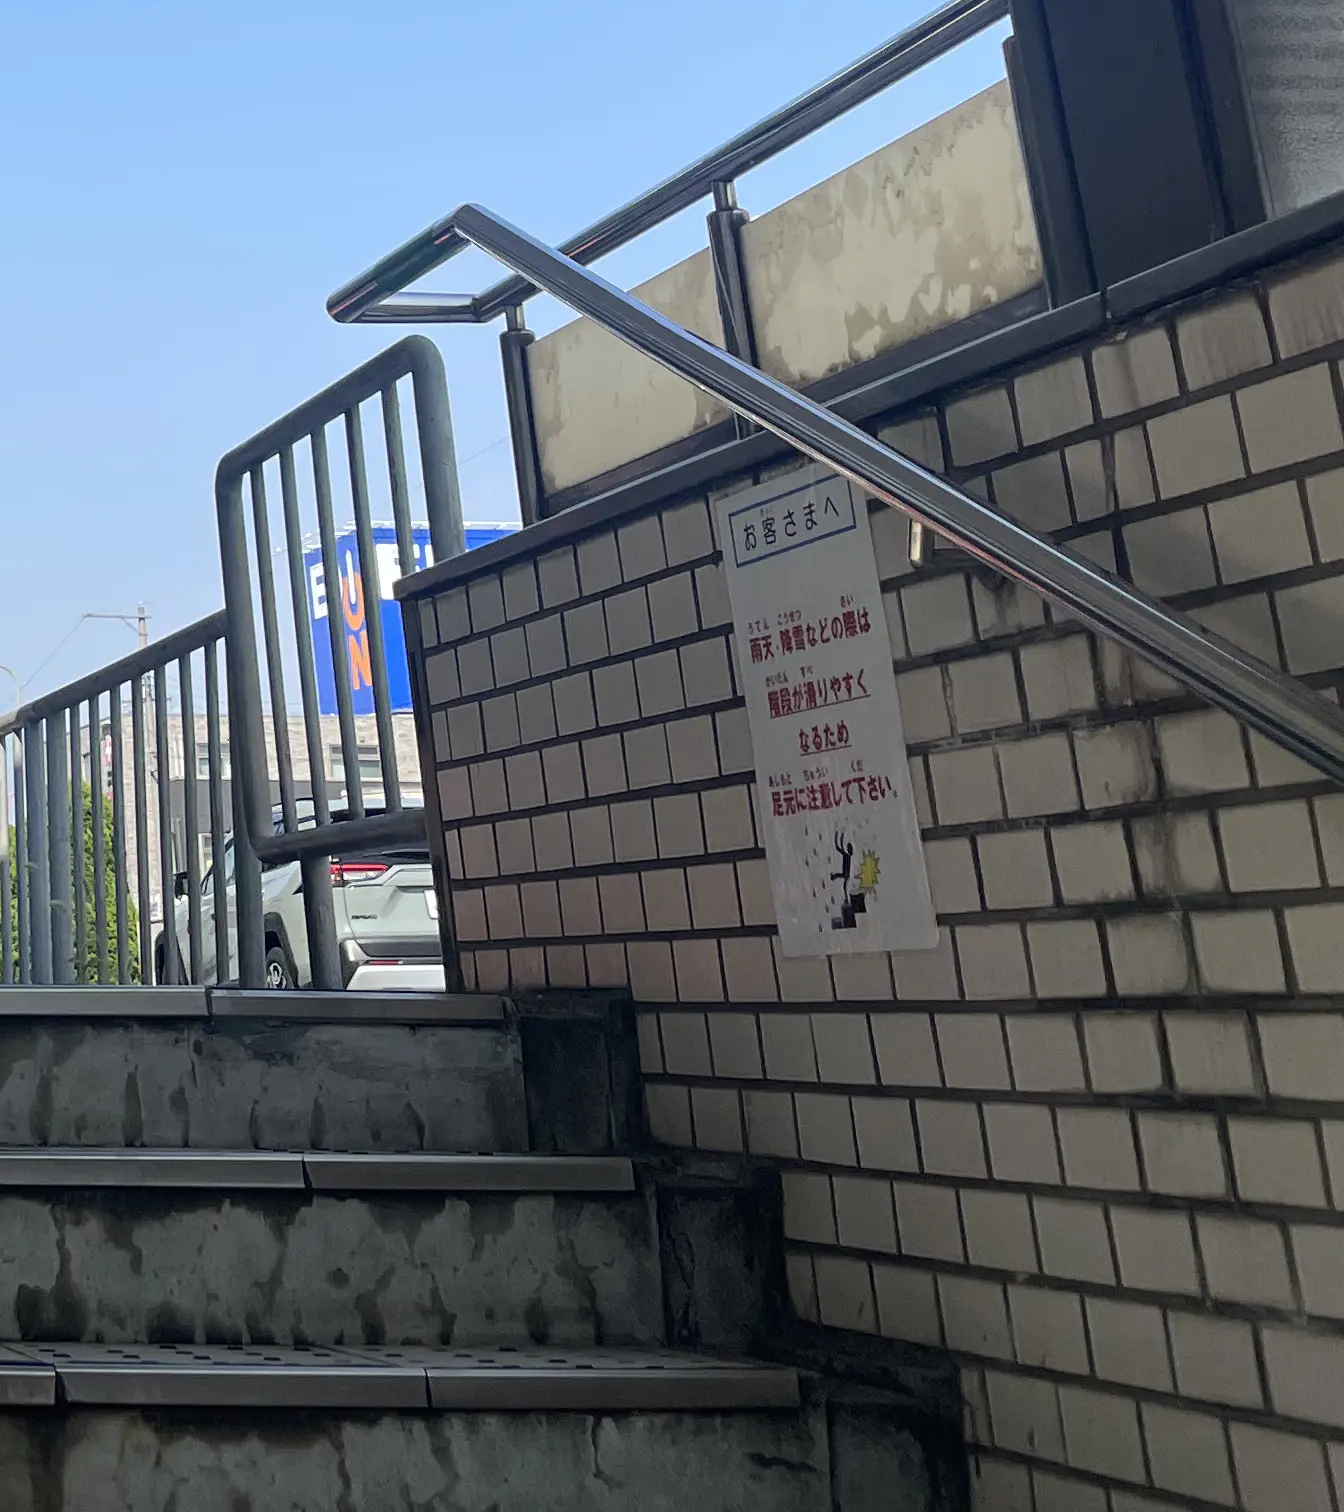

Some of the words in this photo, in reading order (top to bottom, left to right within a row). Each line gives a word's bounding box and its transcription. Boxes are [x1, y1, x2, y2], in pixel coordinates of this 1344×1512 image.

[743, 495, 840, 552] お客さまへ
[748, 606, 872, 665] 雨天・降雪などの際は
[798, 719, 850, 754] なるため
